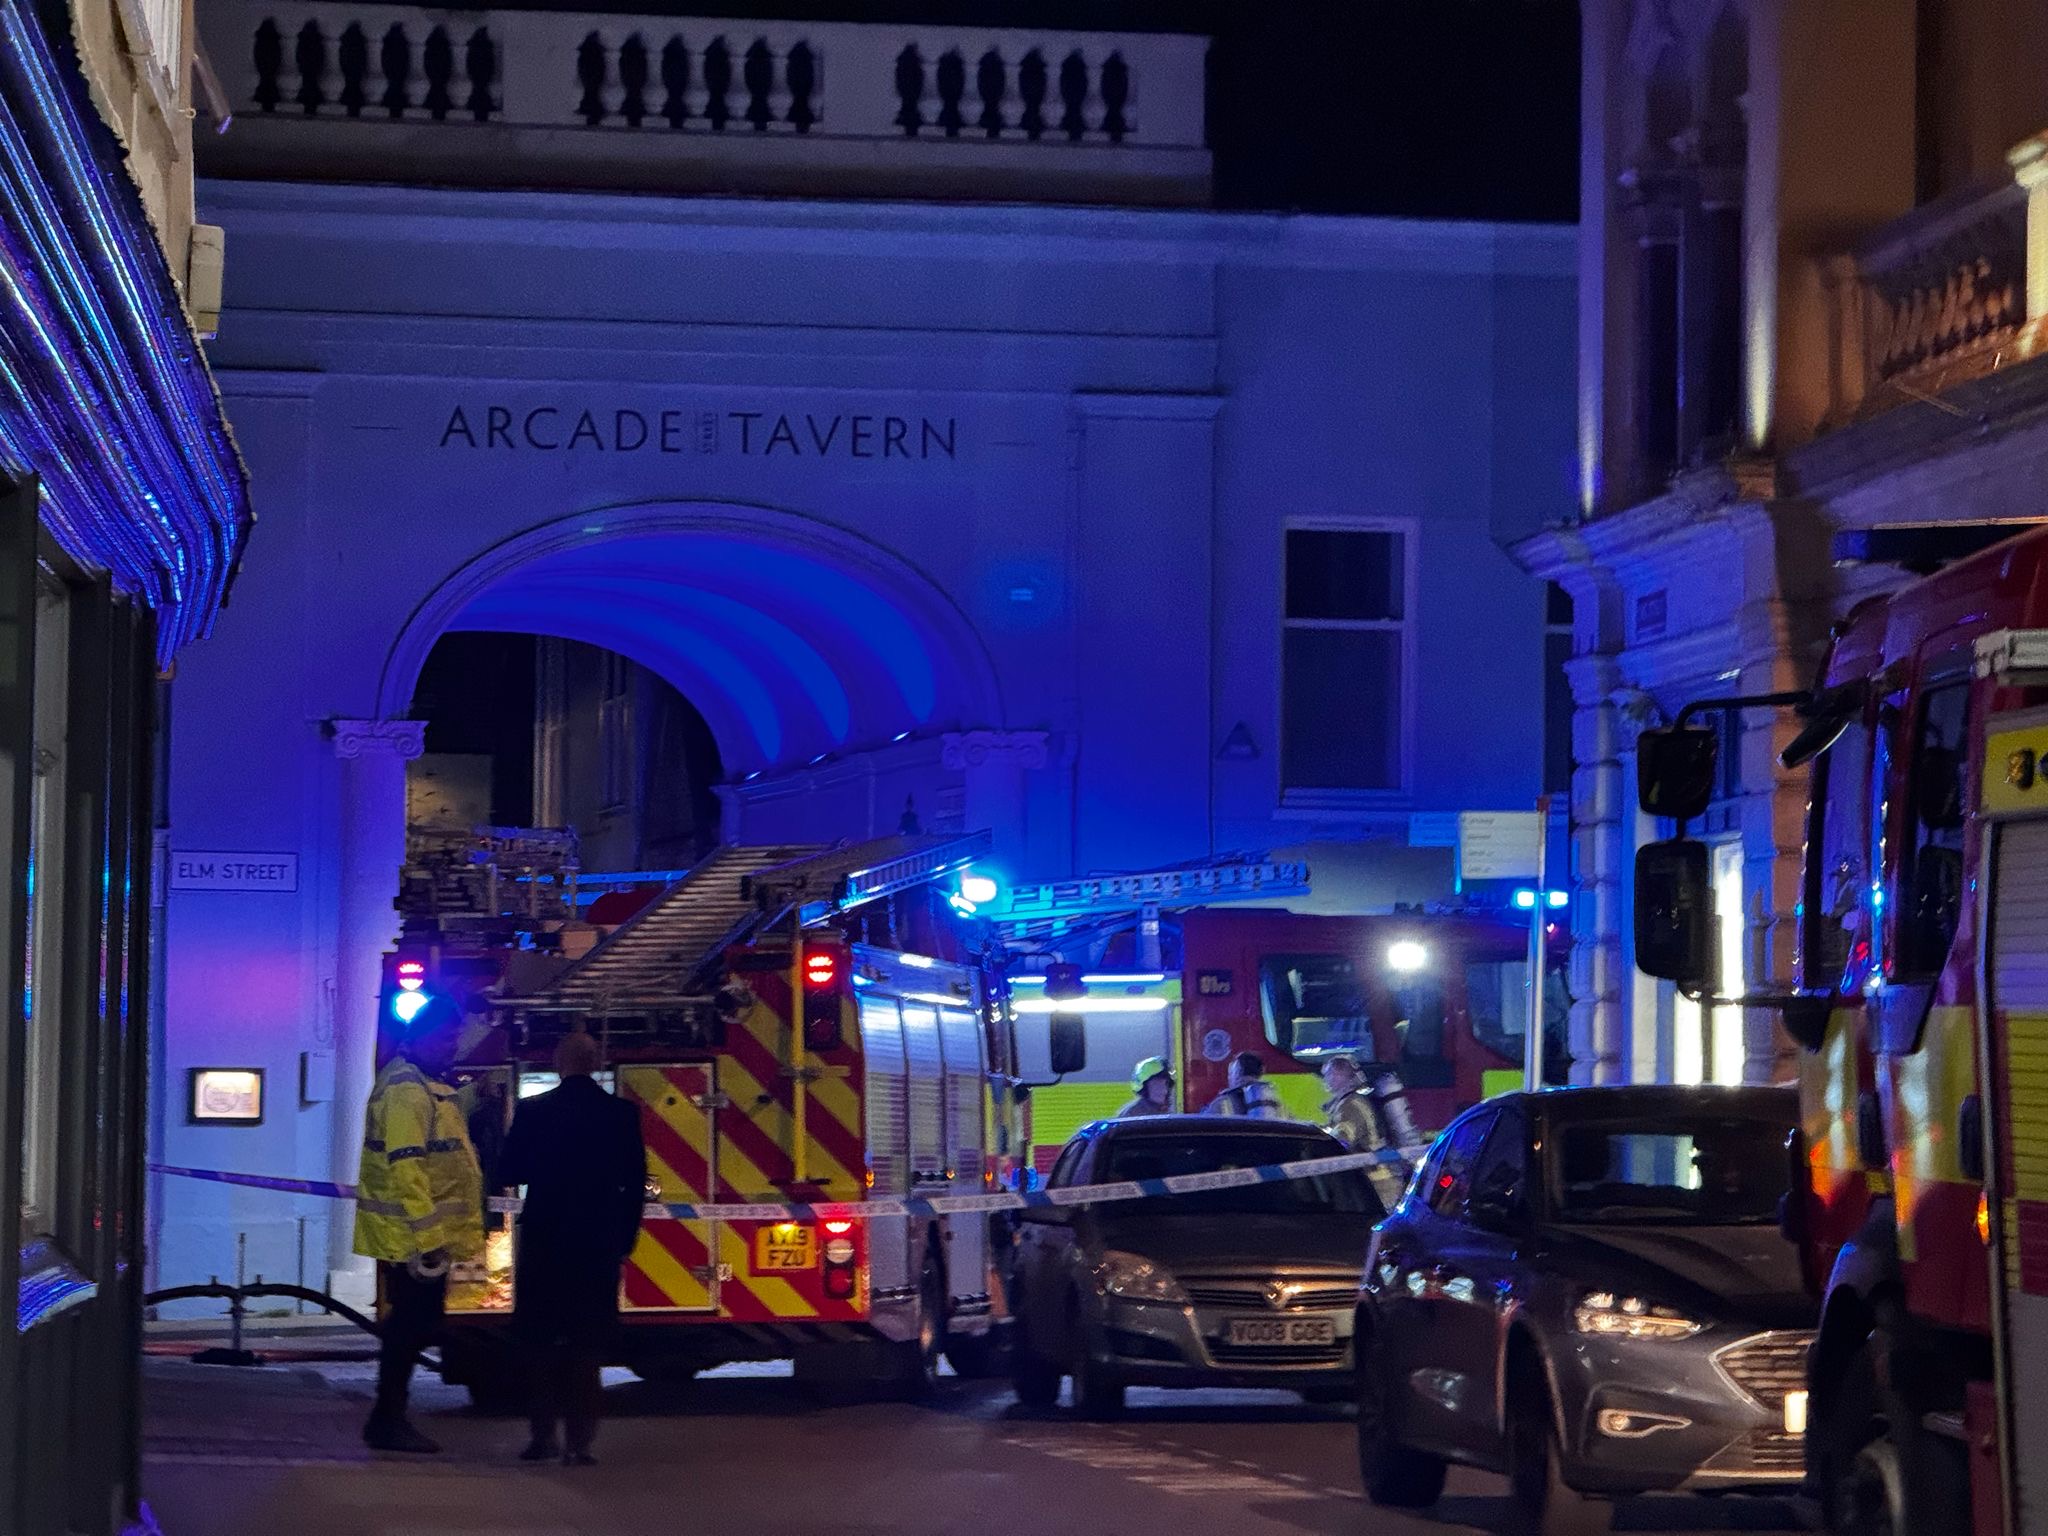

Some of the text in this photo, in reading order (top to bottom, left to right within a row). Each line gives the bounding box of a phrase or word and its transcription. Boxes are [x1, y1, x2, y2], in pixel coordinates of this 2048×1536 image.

[440, 404, 957, 460] ARCADE TAVERN
[178, 862, 288, 880] ELM STREET
